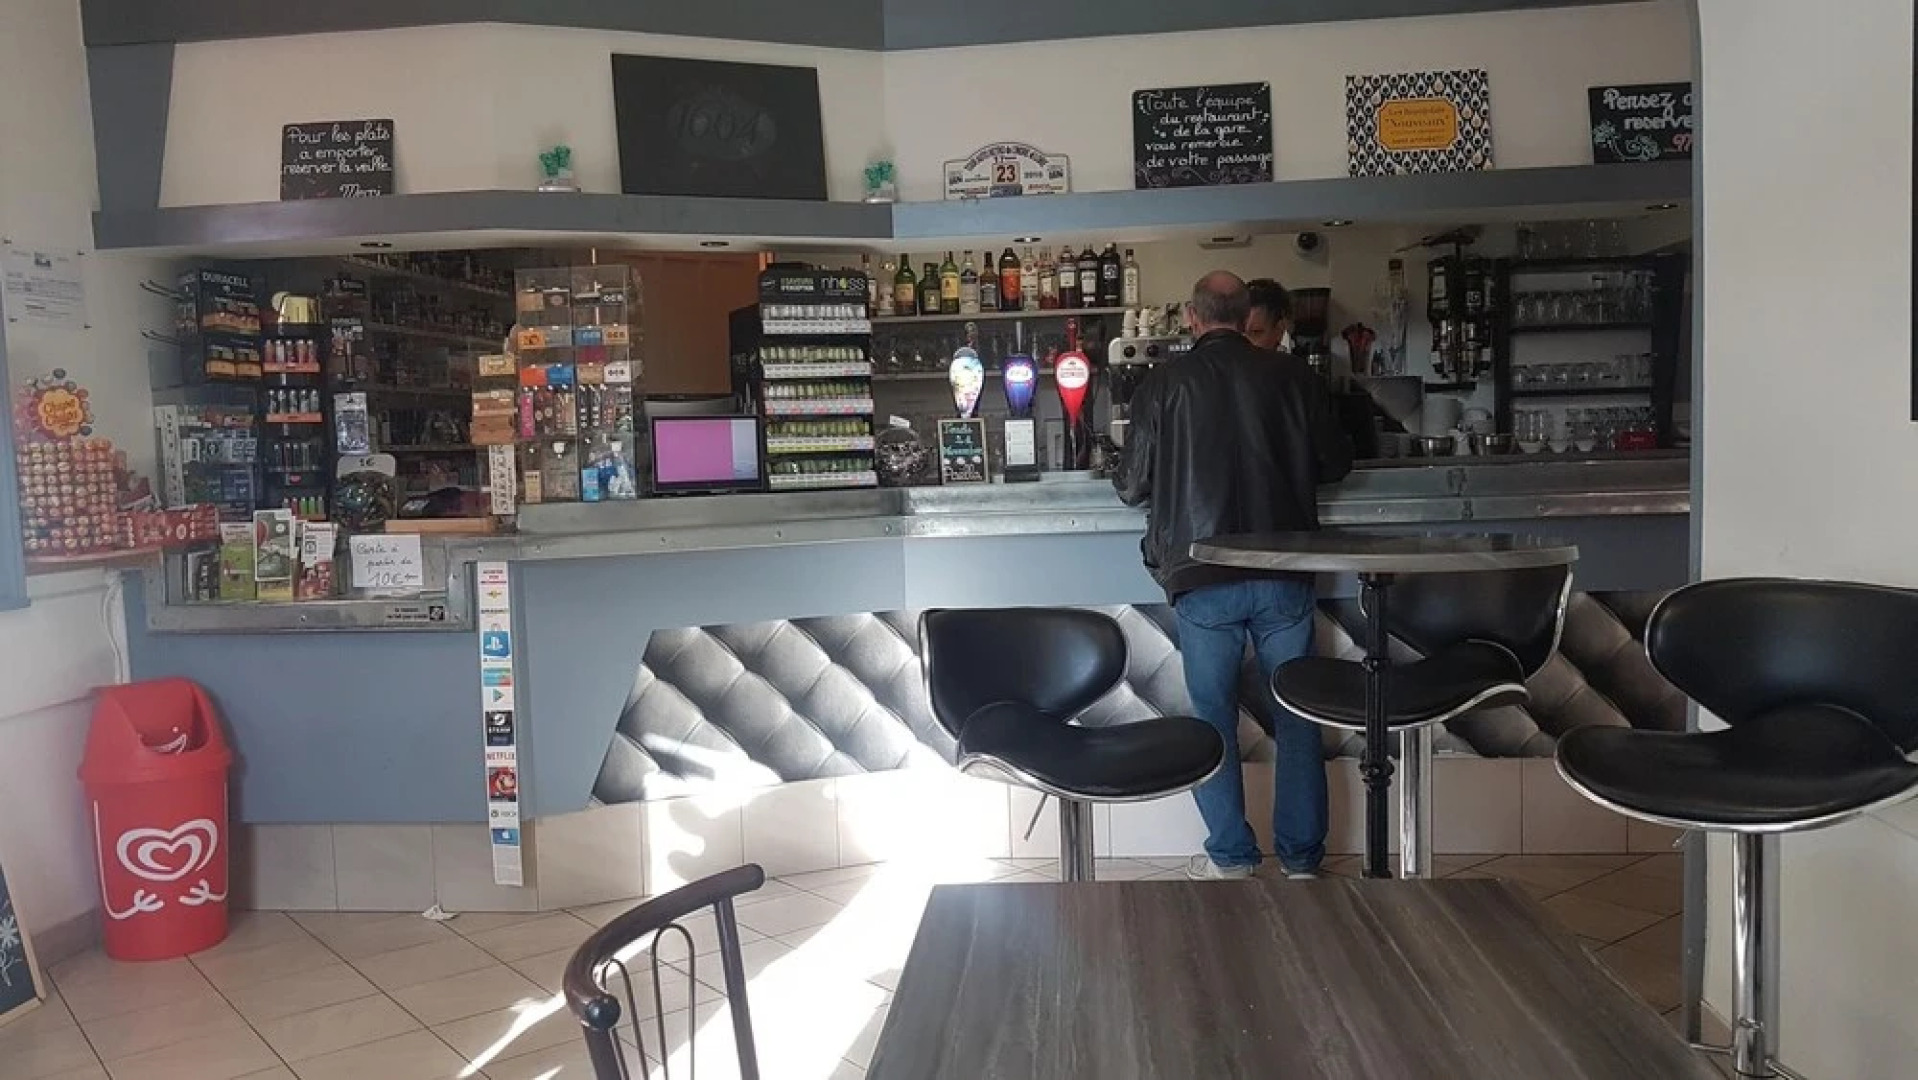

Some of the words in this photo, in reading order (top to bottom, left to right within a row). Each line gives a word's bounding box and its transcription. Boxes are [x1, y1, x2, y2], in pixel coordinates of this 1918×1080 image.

[1139, 90, 1189, 111] Toute
[1197, 88, 1256, 110] l'équipe
[1603, 88, 1677, 115] Pensez
[1160, 112, 1181, 125] du
[1184, 107, 1262, 124] restaurant
[287, 126, 327, 144] Pour
[332, 124, 352, 142] les
[355, 121, 390, 146] plats
[1173, 124, 1191, 137] de
[1195, 123, 1211, 136] la
[1214, 125, 1252, 141] gare
[315, 142, 378, 161] emporter
[1145, 141, 1176, 152] vous
[1181, 137, 1244, 150] remercie
[339, 156, 353, 173] la
[355, 155, 392, 172] veille
[1146, 154, 1165, 168] de
[1168, 151, 1209, 166] votre
[1217, 152, 1273, 169] passage
[996, 164, 1016, 183] 23
[339, 183, 382, 198] Merci
[202, 271, 249, 288] DURACELL
[488, 726, 511, 734] STEAM
[486, 752, 515, 761] NETFLIX
